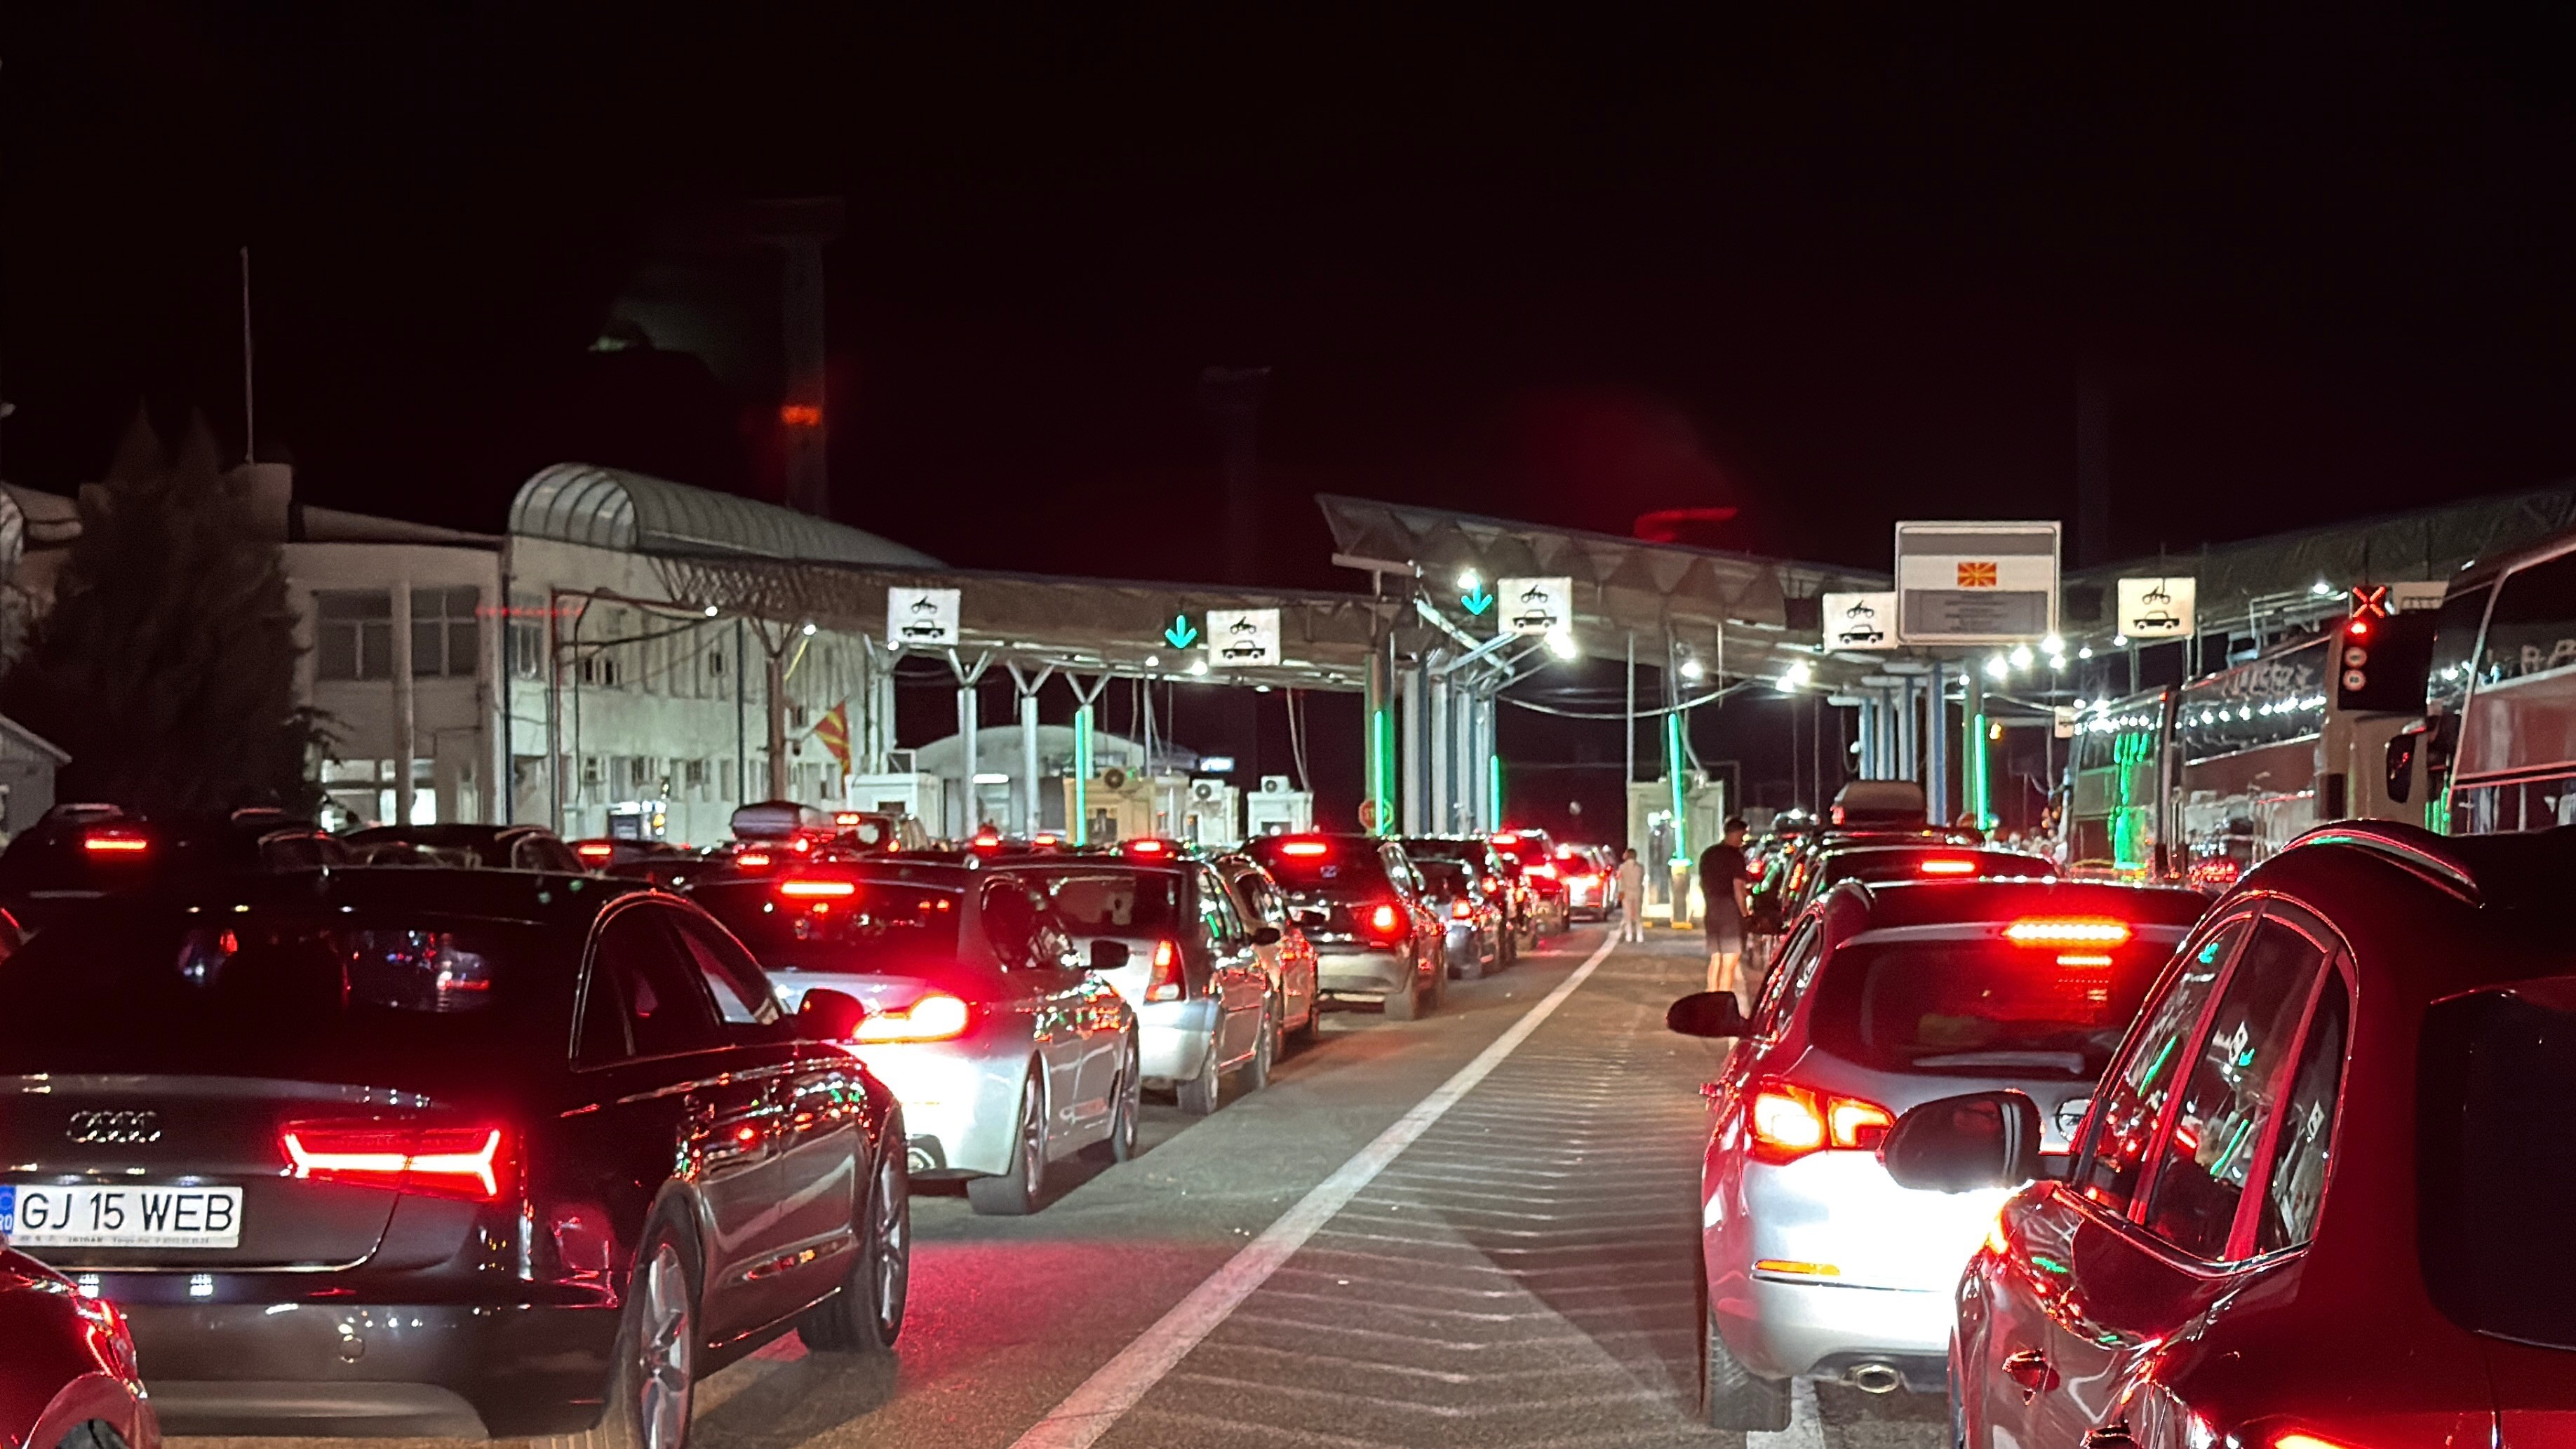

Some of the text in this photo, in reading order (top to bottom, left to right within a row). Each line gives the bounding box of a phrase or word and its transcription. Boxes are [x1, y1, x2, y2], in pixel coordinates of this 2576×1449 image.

[22, 1192, 234, 1232] GJ 15 WEB
